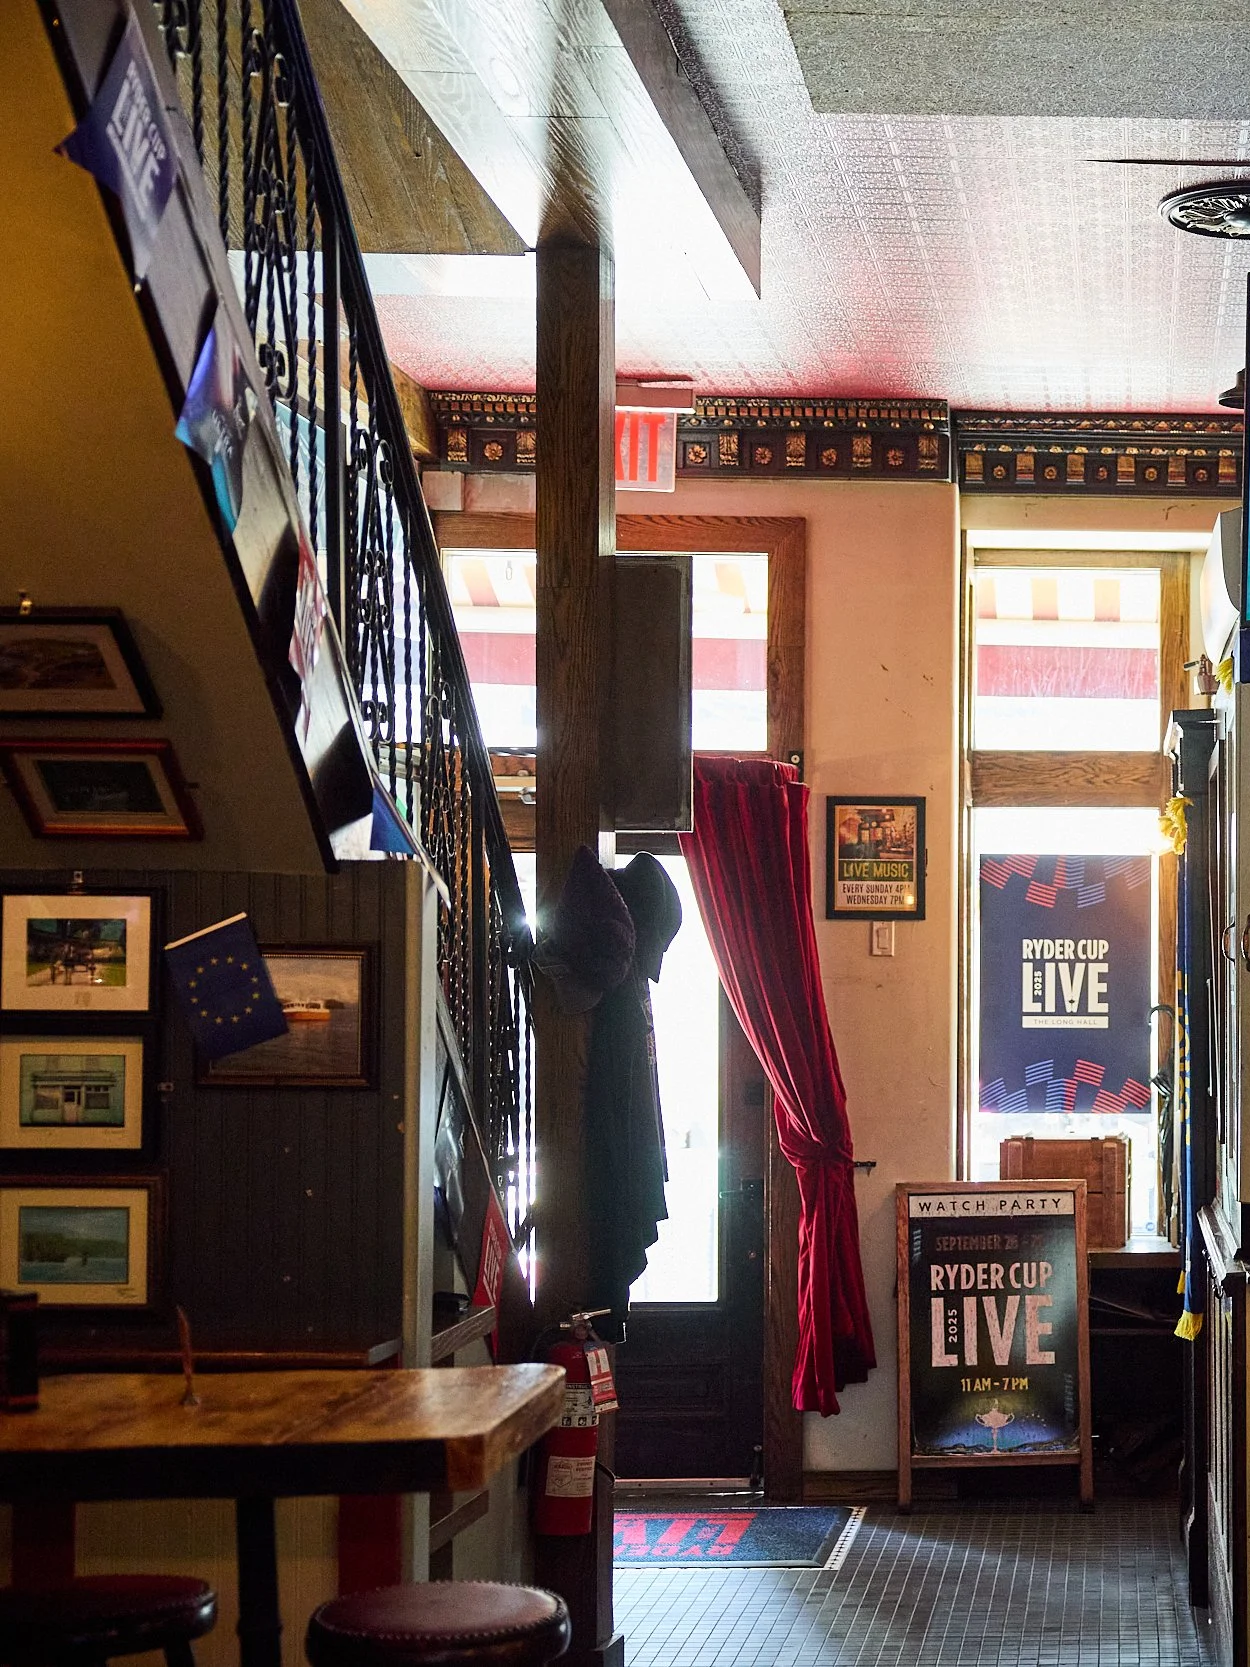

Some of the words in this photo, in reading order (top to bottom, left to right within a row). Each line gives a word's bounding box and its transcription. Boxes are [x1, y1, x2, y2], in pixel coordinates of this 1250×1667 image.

[112, 79, 161, 207] LIVE
[843, 863, 869, 877] LIVE
[873, 863, 909, 877] MUSIC
[842, 884, 863, 893] EVERY
[866, 884, 892, 893] SUNDAY
[847, 896, 888, 905] WEDNESDAY
[1022, 939, 1076, 960] RYDER
[1077, 939, 1110, 960] CUP
[1022, 962, 1109, 1013] LIVE
[1034, 970, 1043, 996] 2025
[919, 1200, 986, 1213] WATCH
[999, 1198, 1062, 1211] PARTY
[936, 1235, 1000, 1251] SEPTEMBER
[930, 1262, 1005, 1291] RYDER
[1009, 1261, 1053, 1290] CUP
[930, 1294, 1056, 1368] LIVE
[947, 1308, 958, 1344] 2025
[961, 1378, 971, 1392] 11
[973, 1378, 991, 1392] AM
[1002, 1378, 1009, 1391] 7
[1013, 1377, 1029, 1391] PM
[614, 1545, 736, 1557] RYDE
